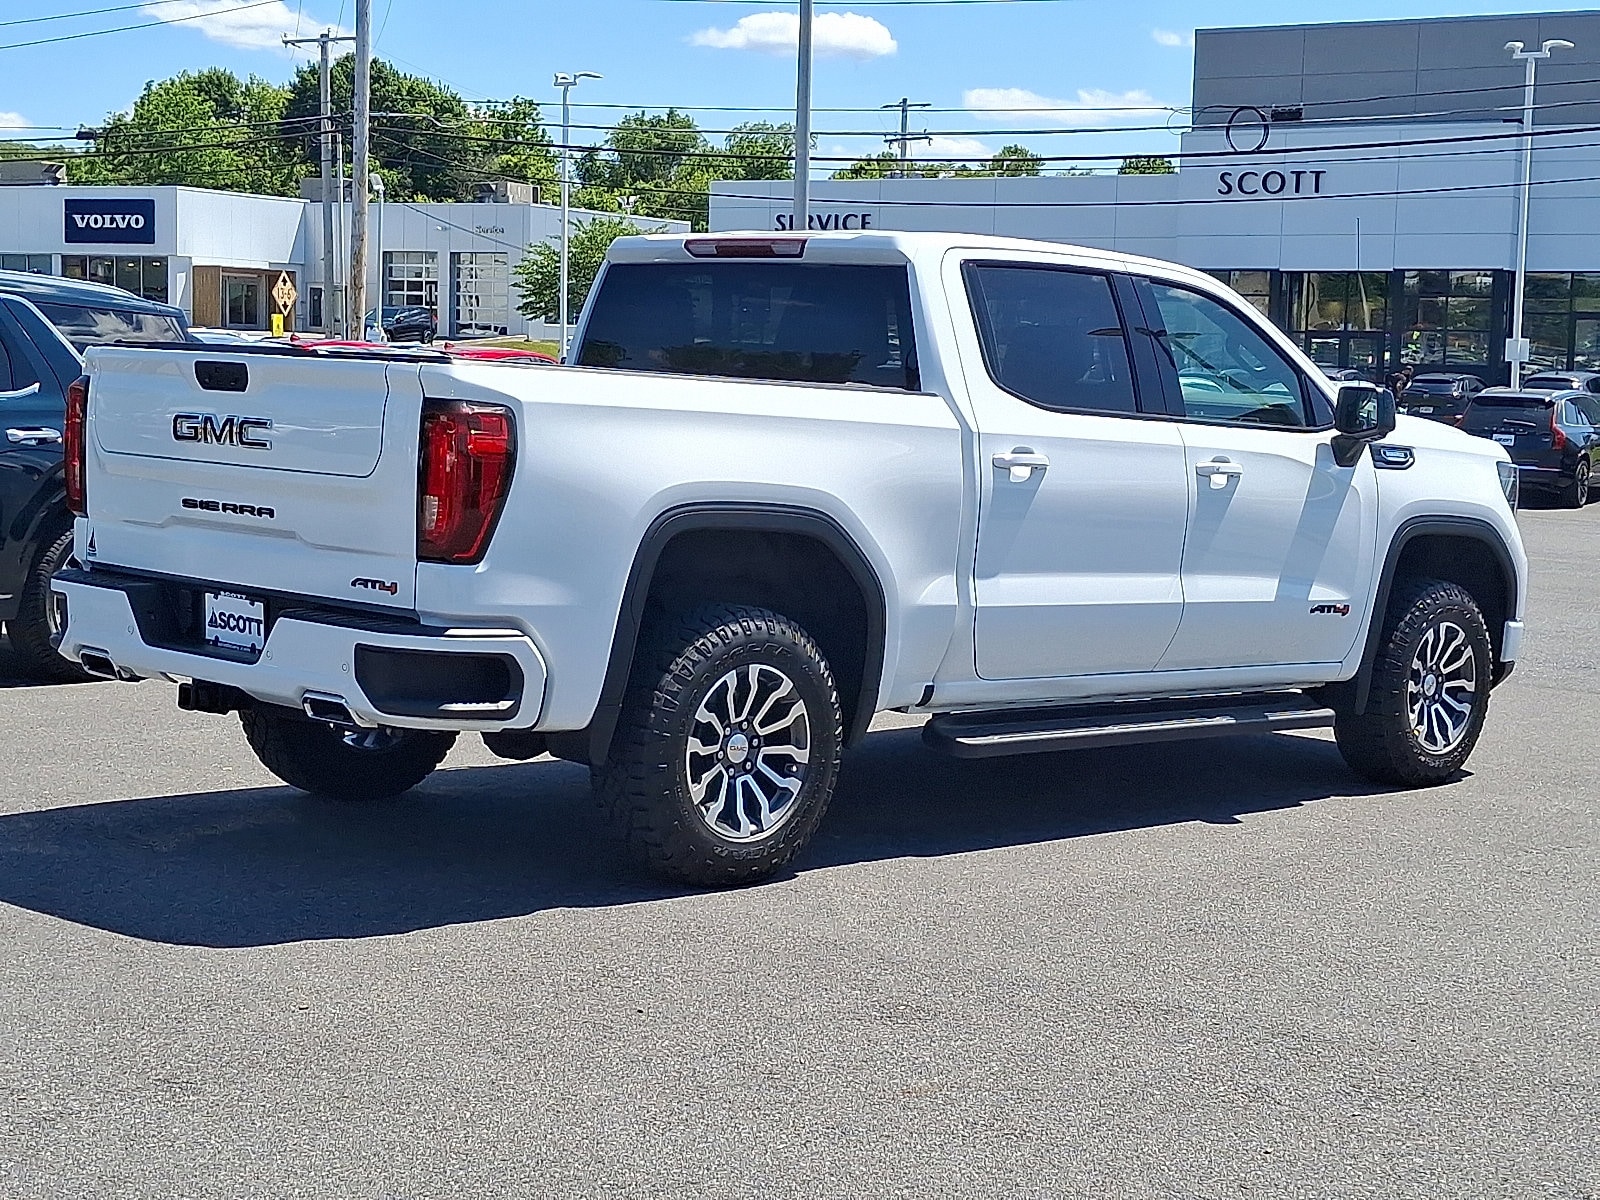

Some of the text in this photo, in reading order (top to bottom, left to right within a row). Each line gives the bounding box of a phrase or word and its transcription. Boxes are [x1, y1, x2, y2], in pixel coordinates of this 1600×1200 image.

[1217, 170, 1327, 195] SCOTT
[72, 214, 145, 229] VOLVO
[172, 412, 273, 451] GMC
[181, 498, 275, 519] SIERRA
[350, 577, 398, 596] AT4
[1309, 604, 1350, 617] AT4
[218, 611, 263, 637] SCOTT
